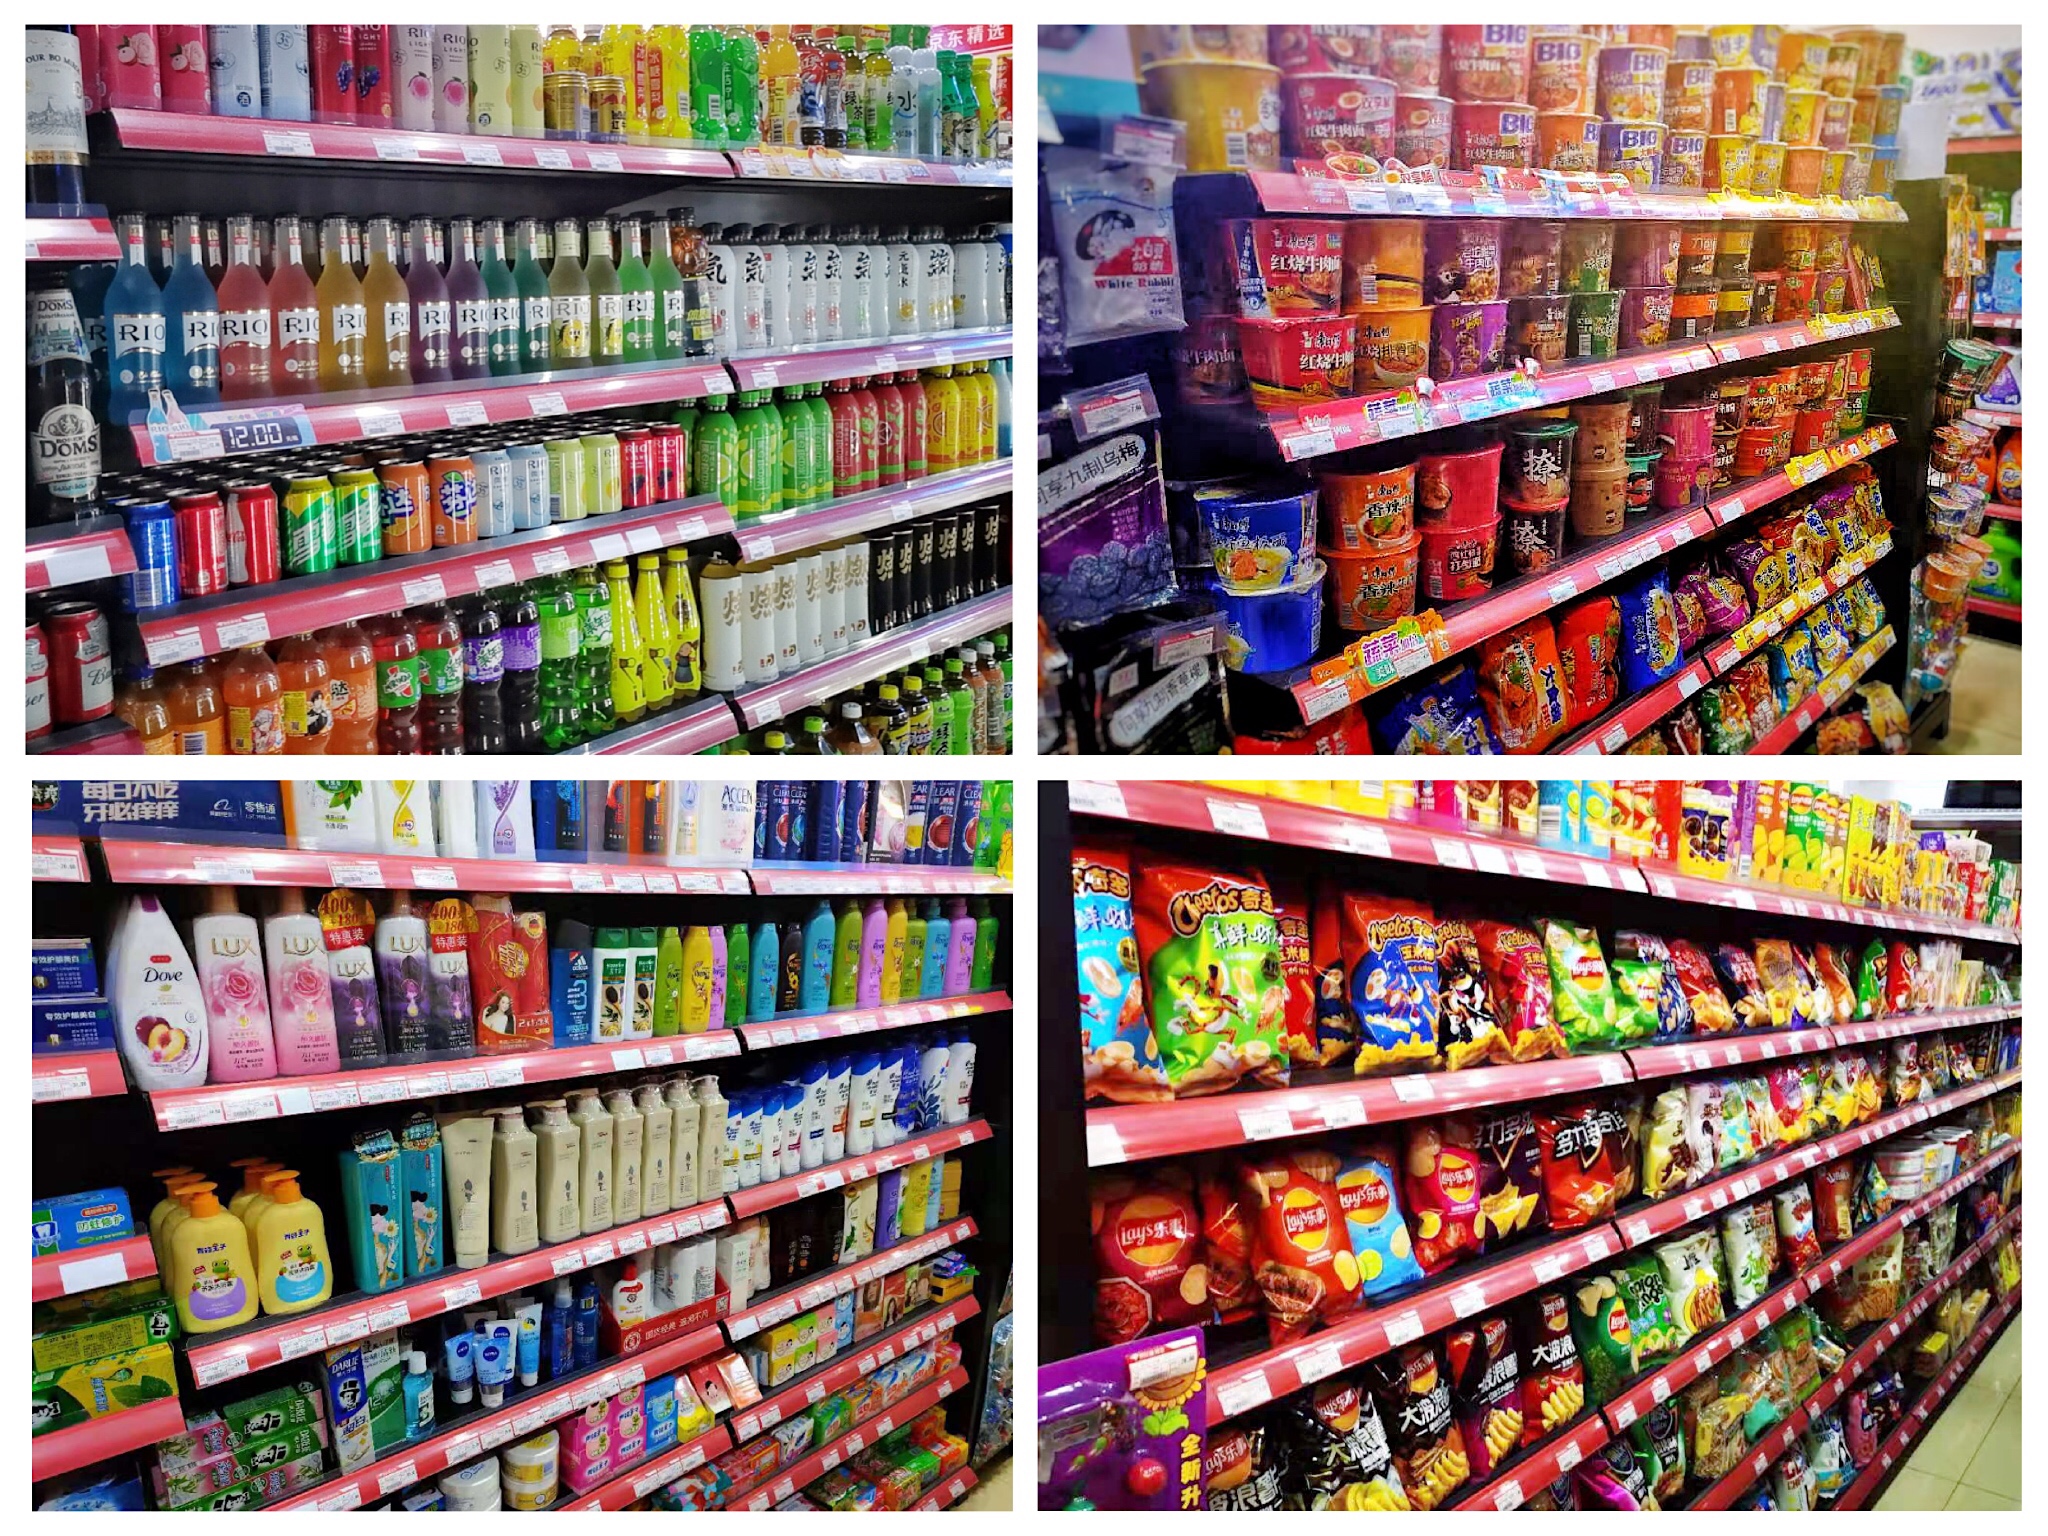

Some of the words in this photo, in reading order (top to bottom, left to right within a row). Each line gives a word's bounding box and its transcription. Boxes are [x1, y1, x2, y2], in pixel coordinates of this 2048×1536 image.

[929, 23, 1006, 51] 京东精选
[1484, 25, 1526, 44] BIG
[1537, 42, 1582, 61] BIG
[1632, 56, 1664, 73] BIG
[1622, 130, 1656, 149] BIG
[1671, 137, 1704, 154] BIG
[1270, 254, 1342, 272] 红烧牛肉面
[1093, 278, 1134, 290] White
[1137, 277, 1175, 289] Rabbit
[38, 301, 74, 313] DOMS
[532, 306, 549, 320] RI
[221, 319, 269, 337] RIO
[338, 313, 366, 329] RI
[388, 311, 409, 326] RI
[118, 324, 165, 343] RIO
[226, 422, 283, 449] 12.00
[652, 440, 676, 449] RIO
[40, 437, 98, 458] DOMS
[1522, 448, 1562, 485] 撩
[1362, 631, 1400, 667] 蔬菜
[82, 781, 179, 800] 每日不吃
[721, 784, 753, 805] ACCEN
[963, 787, 981, 799] CLEA
[83, 803, 179, 823] 牙必痒痒
[244, 802, 276, 815] 零售通
[1170, 883, 1239, 936] Cheetos
[329, 930, 365, 946] 特惠装
[391, 935, 426, 954] LUX
[435, 934, 468, 949] 特惠装
[1208, 922, 1281, 950] 真鲜虾
[1367, 917, 1412, 953] Cheetos
[211, 937, 257, 958] LUX
[283, 936, 327, 957] LUX
[143, 966, 183, 983] Dove
[337, 961, 370, 978] LUX
[439, 960, 467, 974] LUX
[1285, 1205, 1327, 1233] Lay's乐事
[332, 1354, 360, 1375] DARLIE
[1180, 1432, 1201, 1511] 全新升
